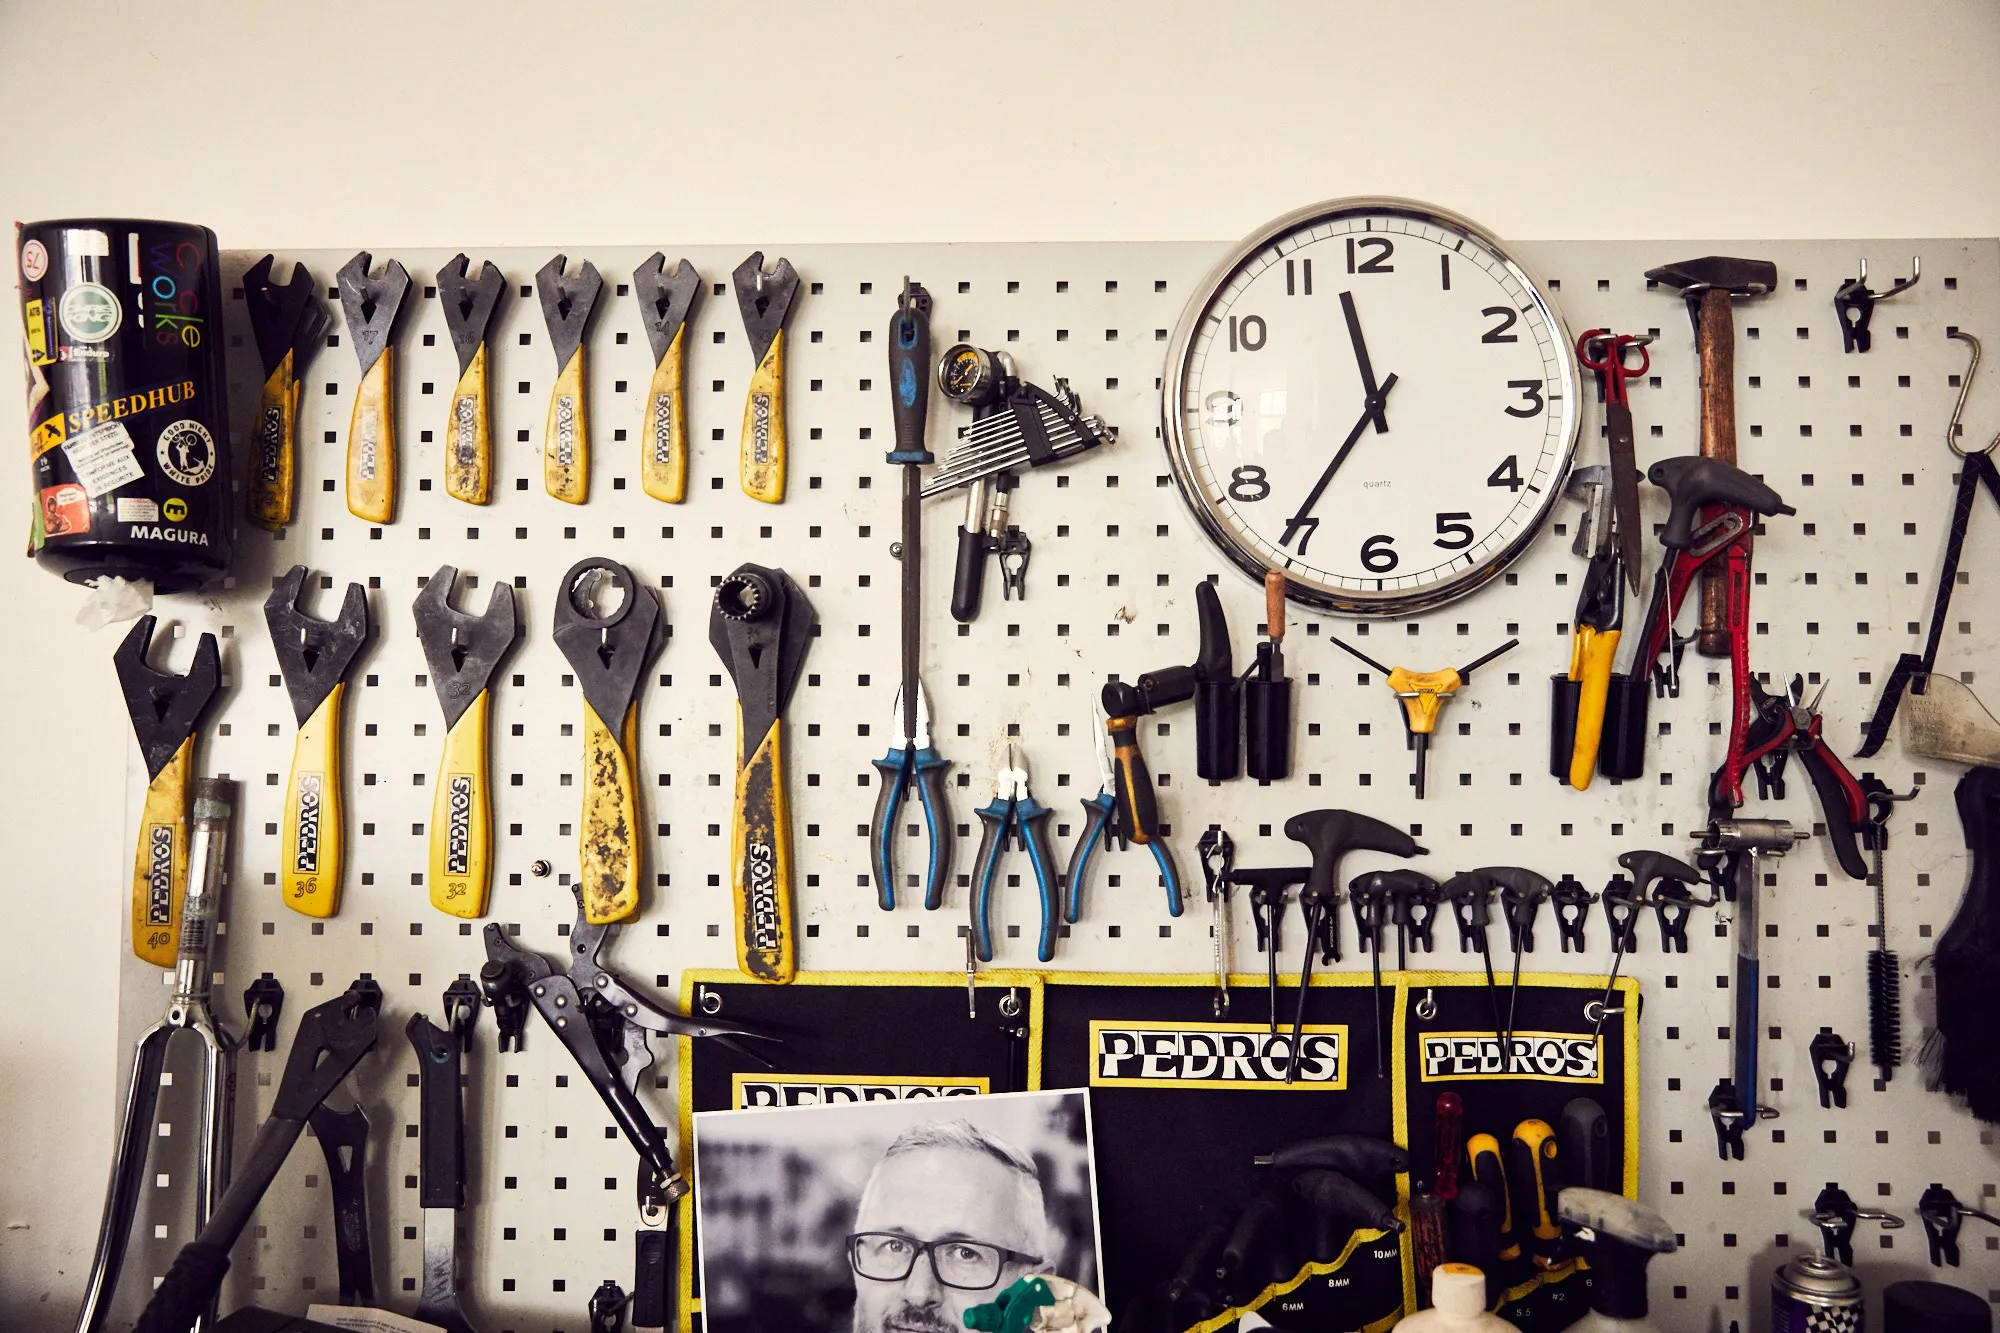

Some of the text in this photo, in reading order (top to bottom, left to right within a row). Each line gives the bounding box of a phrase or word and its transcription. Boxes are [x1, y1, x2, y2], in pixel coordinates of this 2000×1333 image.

[1346, 237, 1394, 274] 12
[1440, 254, 1451, 291] 1
[1286, 258, 1313, 296] 11
[1229, 314, 1267, 352] 10
[1481, 306, 1518, 344] 2
[68, 380, 196, 434] SPEEDHUB
[1504, 379, 1544, 419] 3
[163, 422, 185, 441] GOOD
[558, 396, 573, 464] PEDRO'S
[656, 395, 671, 463] PEDRO'S
[754, 395, 769, 463] PEDRO'S
[163, 462, 213, 484] WHITE PRIDE
[1228, 465, 1270, 502] 8
[1363, 479, 1392, 489] quartz
[1486, 455, 1524, 492] 4
[130, 525, 209, 547] MAGURA
[1285, 517, 1320, 556] 7
[1433, 511, 1475, 549] 5
[1360, 534, 1399, 573] 6
[449, 681, 472, 699] 32
[297, 775, 320, 871] PEDRO'S
[448, 777, 470, 873] PEDRO'S
[150, 827, 172, 922] PEDRO'S
[294, 876, 317, 898] 36
[446, 882, 467, 900] 32
[749, 843, 777, 949] PEDRO'S
[147, 931, 171, 948] 40
[1101, 1032, 1337, 1081] PEDROS
[1426, 1039, 1595, 1077] PEDRO'S
[1552, 1293, 1565, 1301] #2
[1586, 1279, 1593, 1287] 6
[1516, 1308, 1531, 1317] 5.5
